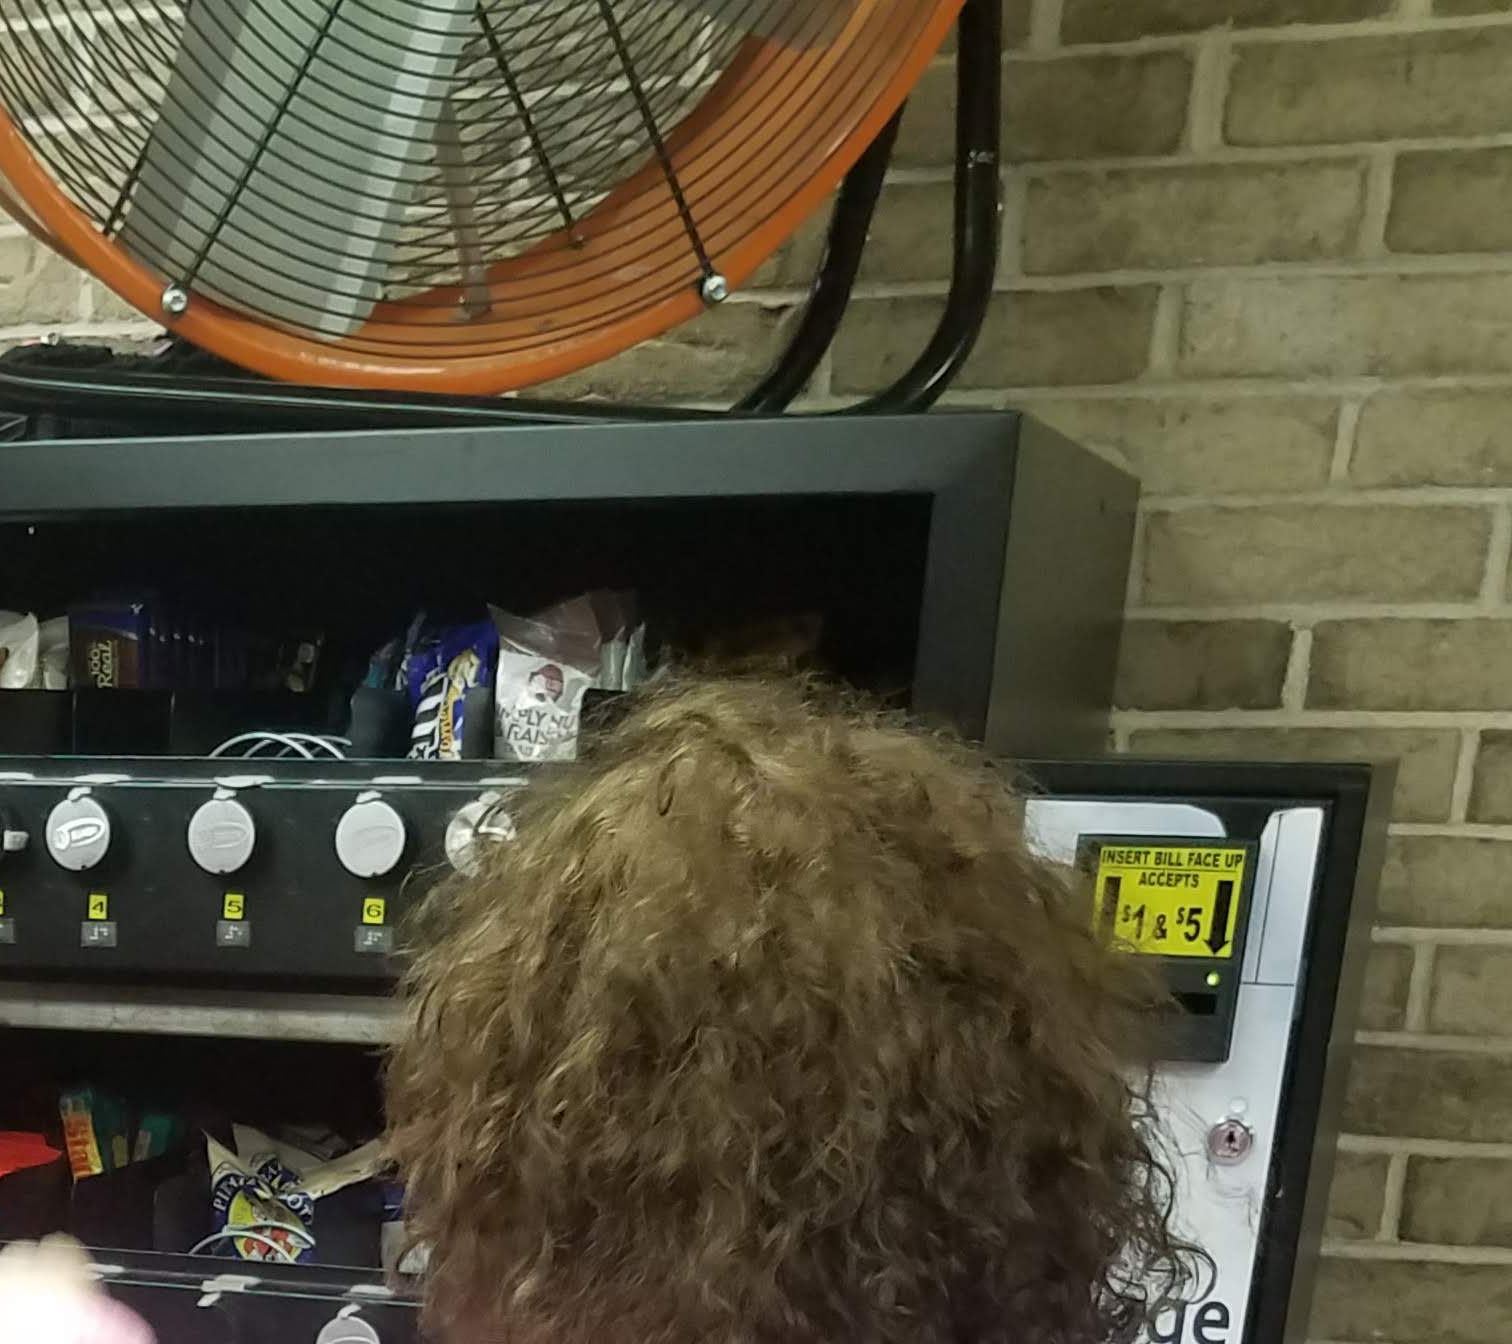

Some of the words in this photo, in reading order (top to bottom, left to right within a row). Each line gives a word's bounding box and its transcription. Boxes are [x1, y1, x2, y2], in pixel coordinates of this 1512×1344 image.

[1101, 850, 1151, 865] INSERT
[1153, 851, 1183, 867] BILL
[1187, 852, 1221, 868] FACE
[1224, 854, 1244, 868] UP
[1137, 871, 1200, 889] ACCEPTS
[91, 900, 105, 913] 4
[226, 899, 242, 914] 5
[365, 903, 382, 918] 6
[1120, 903, 1146, 940] $1
[1153, 914, 1168, 940] &
[1175, 906, 1204, 942] $5
